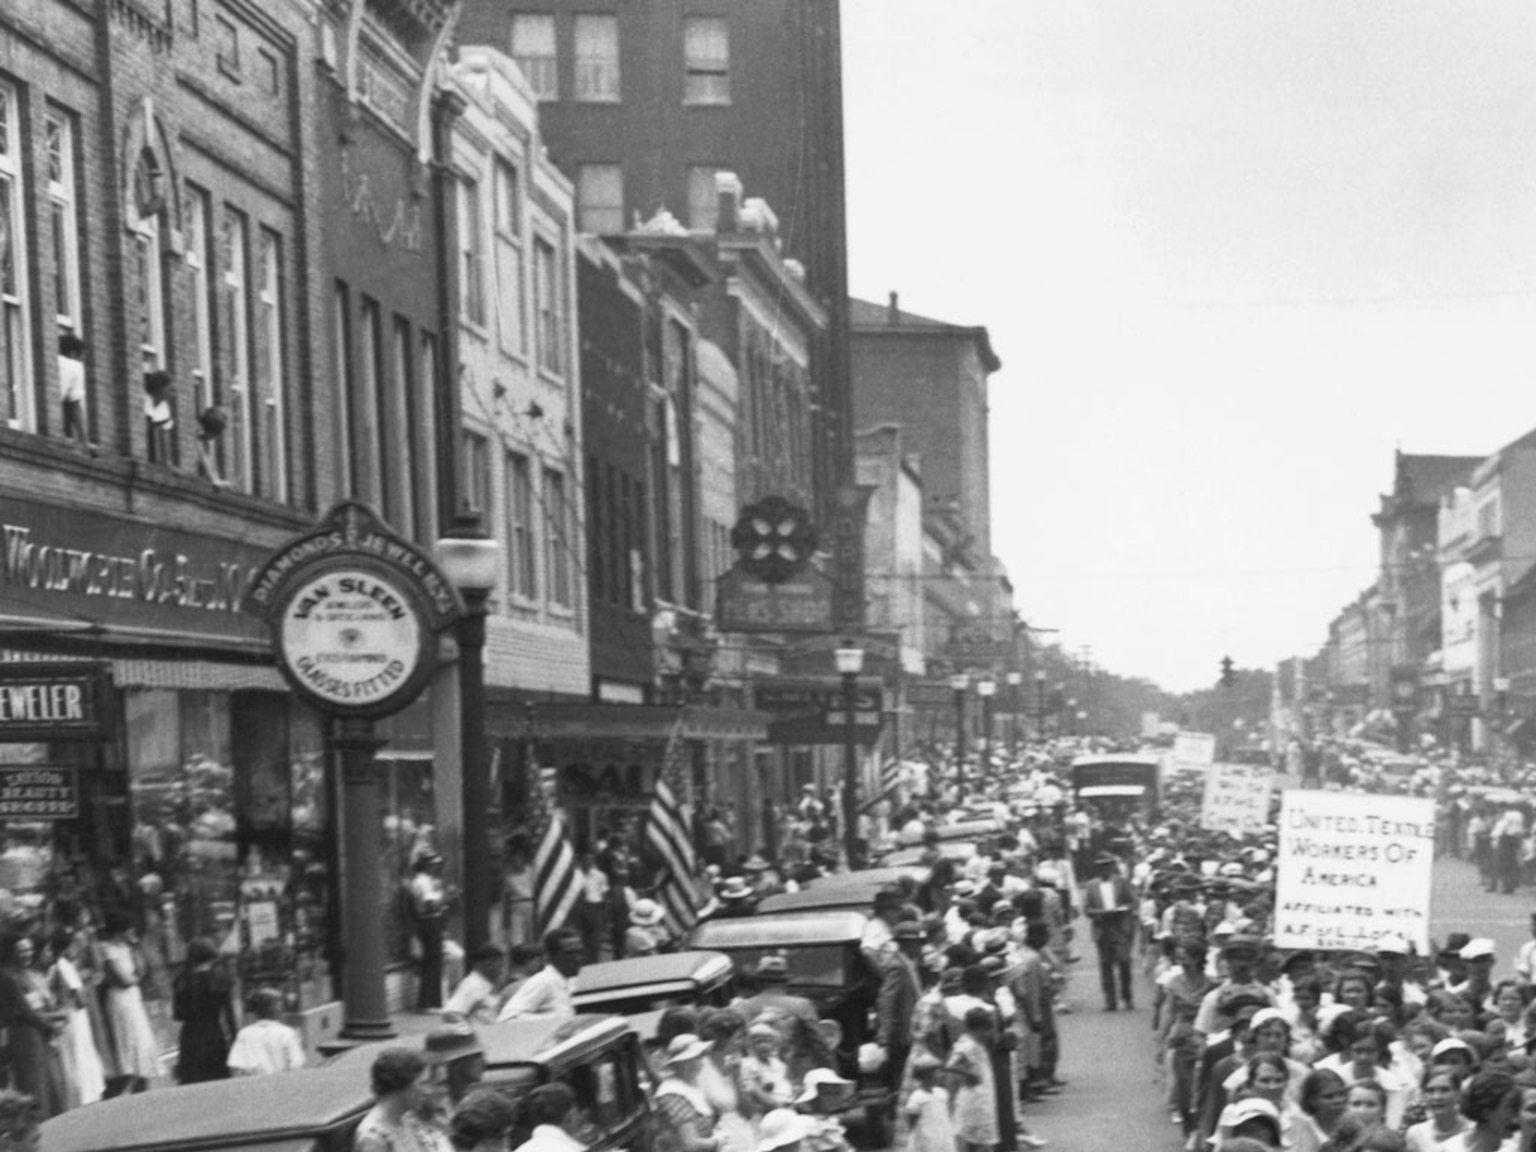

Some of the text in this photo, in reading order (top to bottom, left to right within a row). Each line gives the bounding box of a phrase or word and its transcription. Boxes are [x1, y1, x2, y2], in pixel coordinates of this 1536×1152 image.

[254, 531, 343, 602] DIAMONDS
[293, 577, 407, 621] VAN SLEEN
[353, 659, 406, 697] FITTED
[1288, 807, 1358, 833] UNITED
[1287, 837, 1418, 864] WORKERS OF
[1300, 866, 1377, 888] AMERICA
[1282, 902, 1423, 918] AFFILIATED WITH
